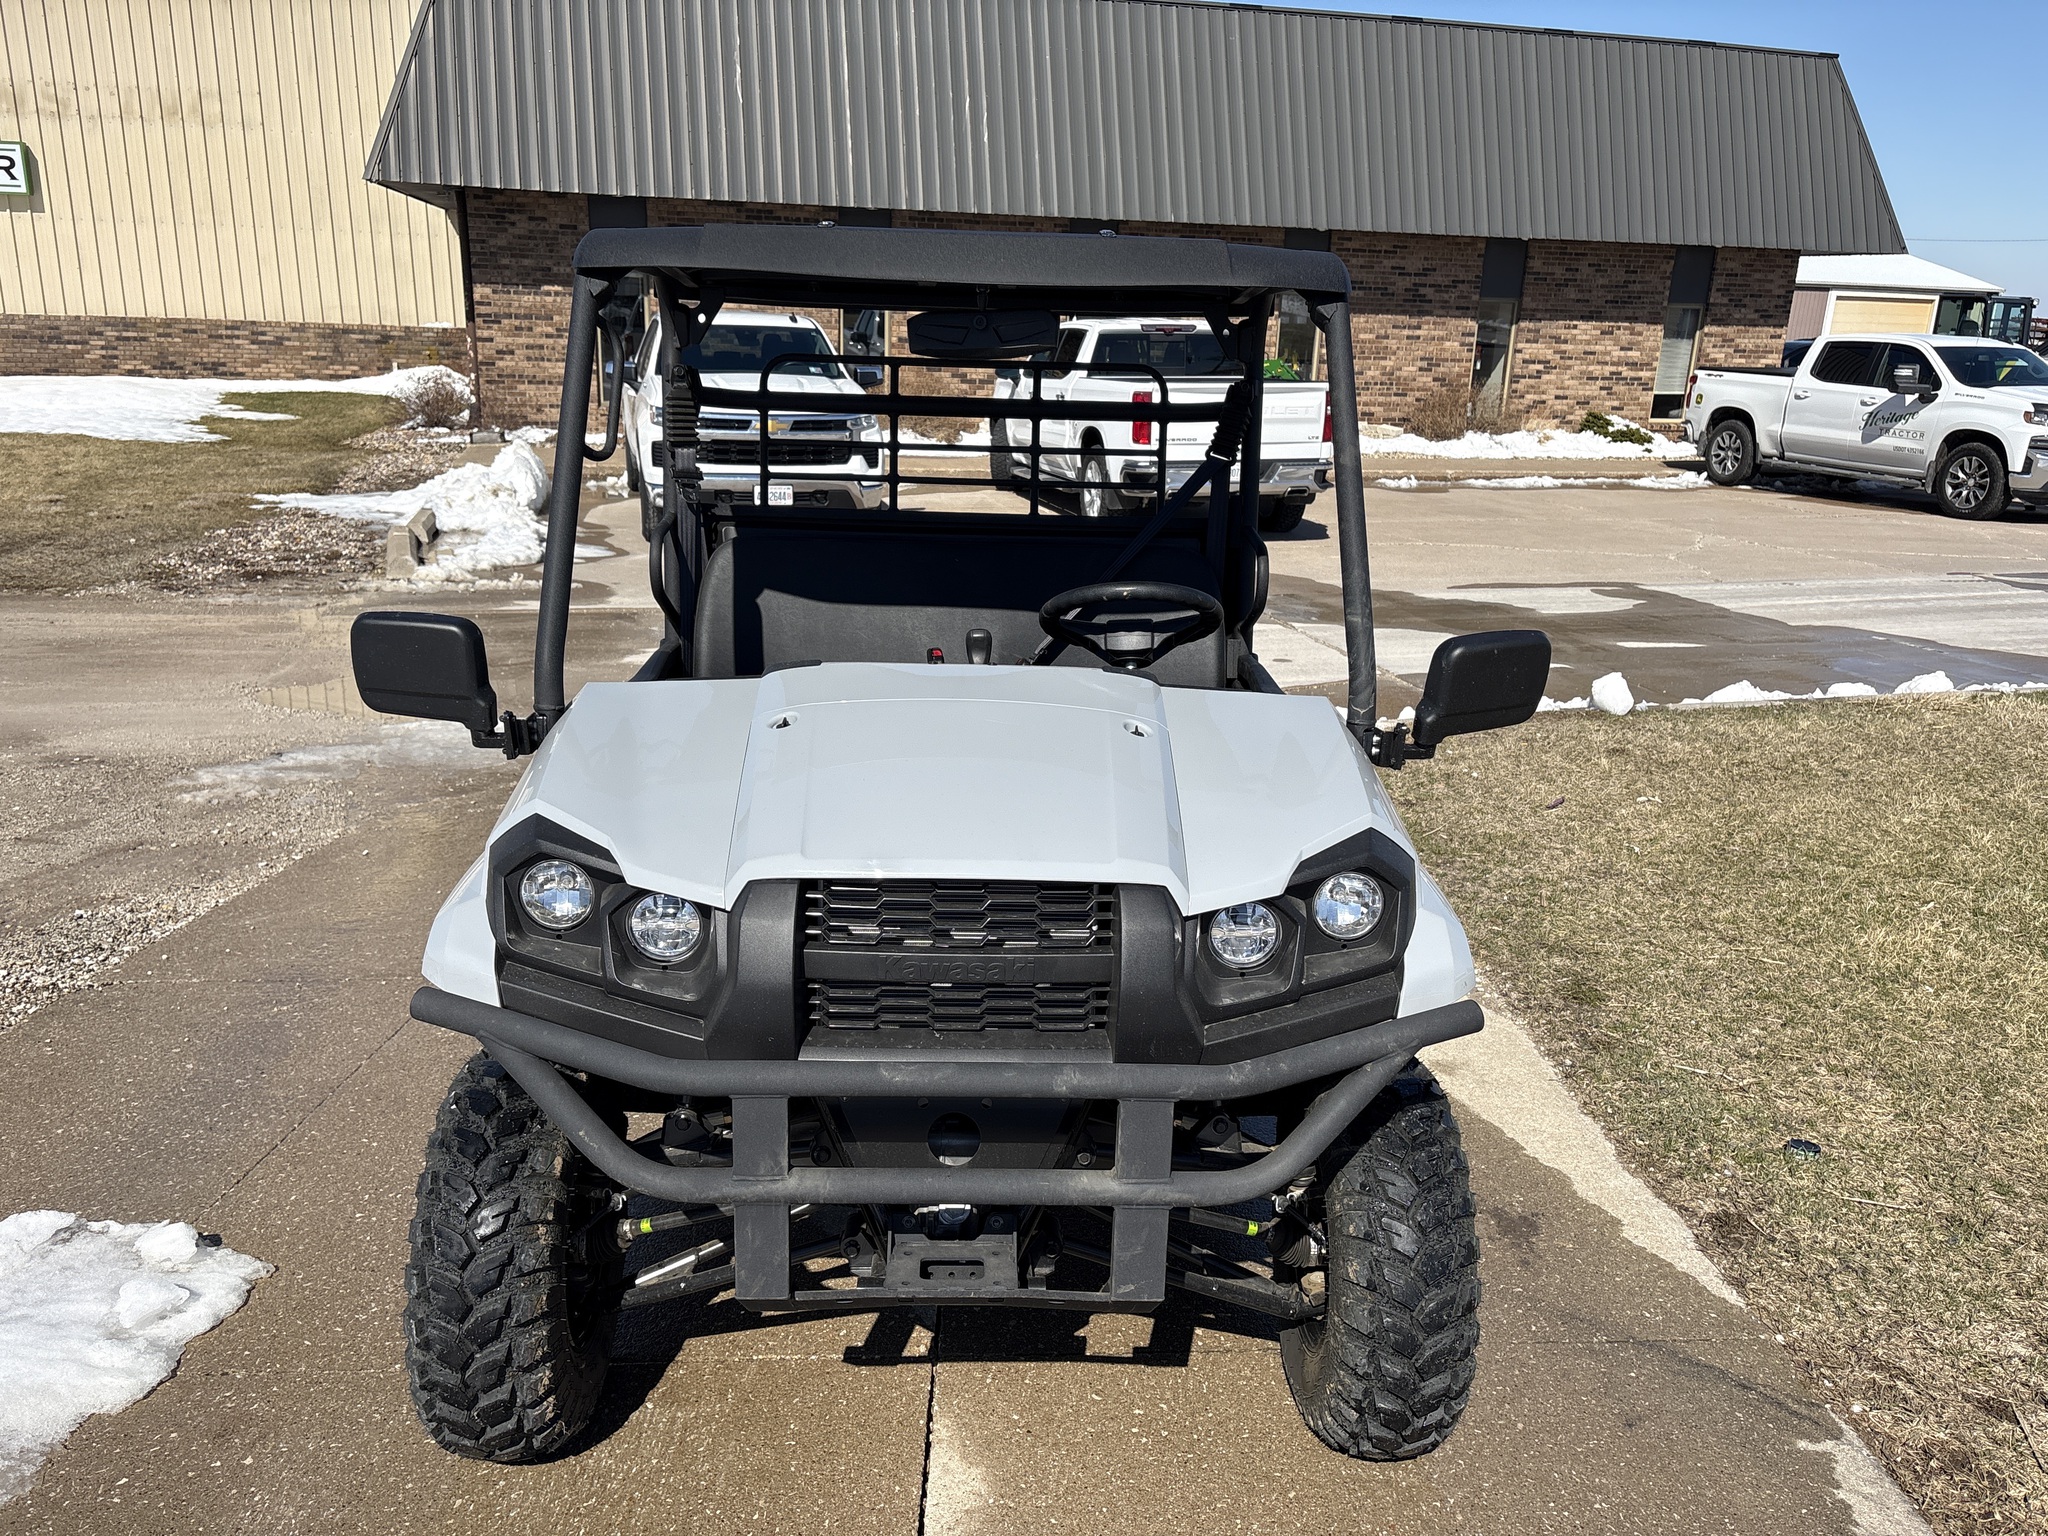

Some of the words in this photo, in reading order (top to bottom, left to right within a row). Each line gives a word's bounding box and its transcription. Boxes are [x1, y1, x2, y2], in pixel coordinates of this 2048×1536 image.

[1858, 409, 1921, 431] Heritage
[1879, 428, 1925, 440] TRACTOR
[879, 955, 1035, 981] Kawasaki
